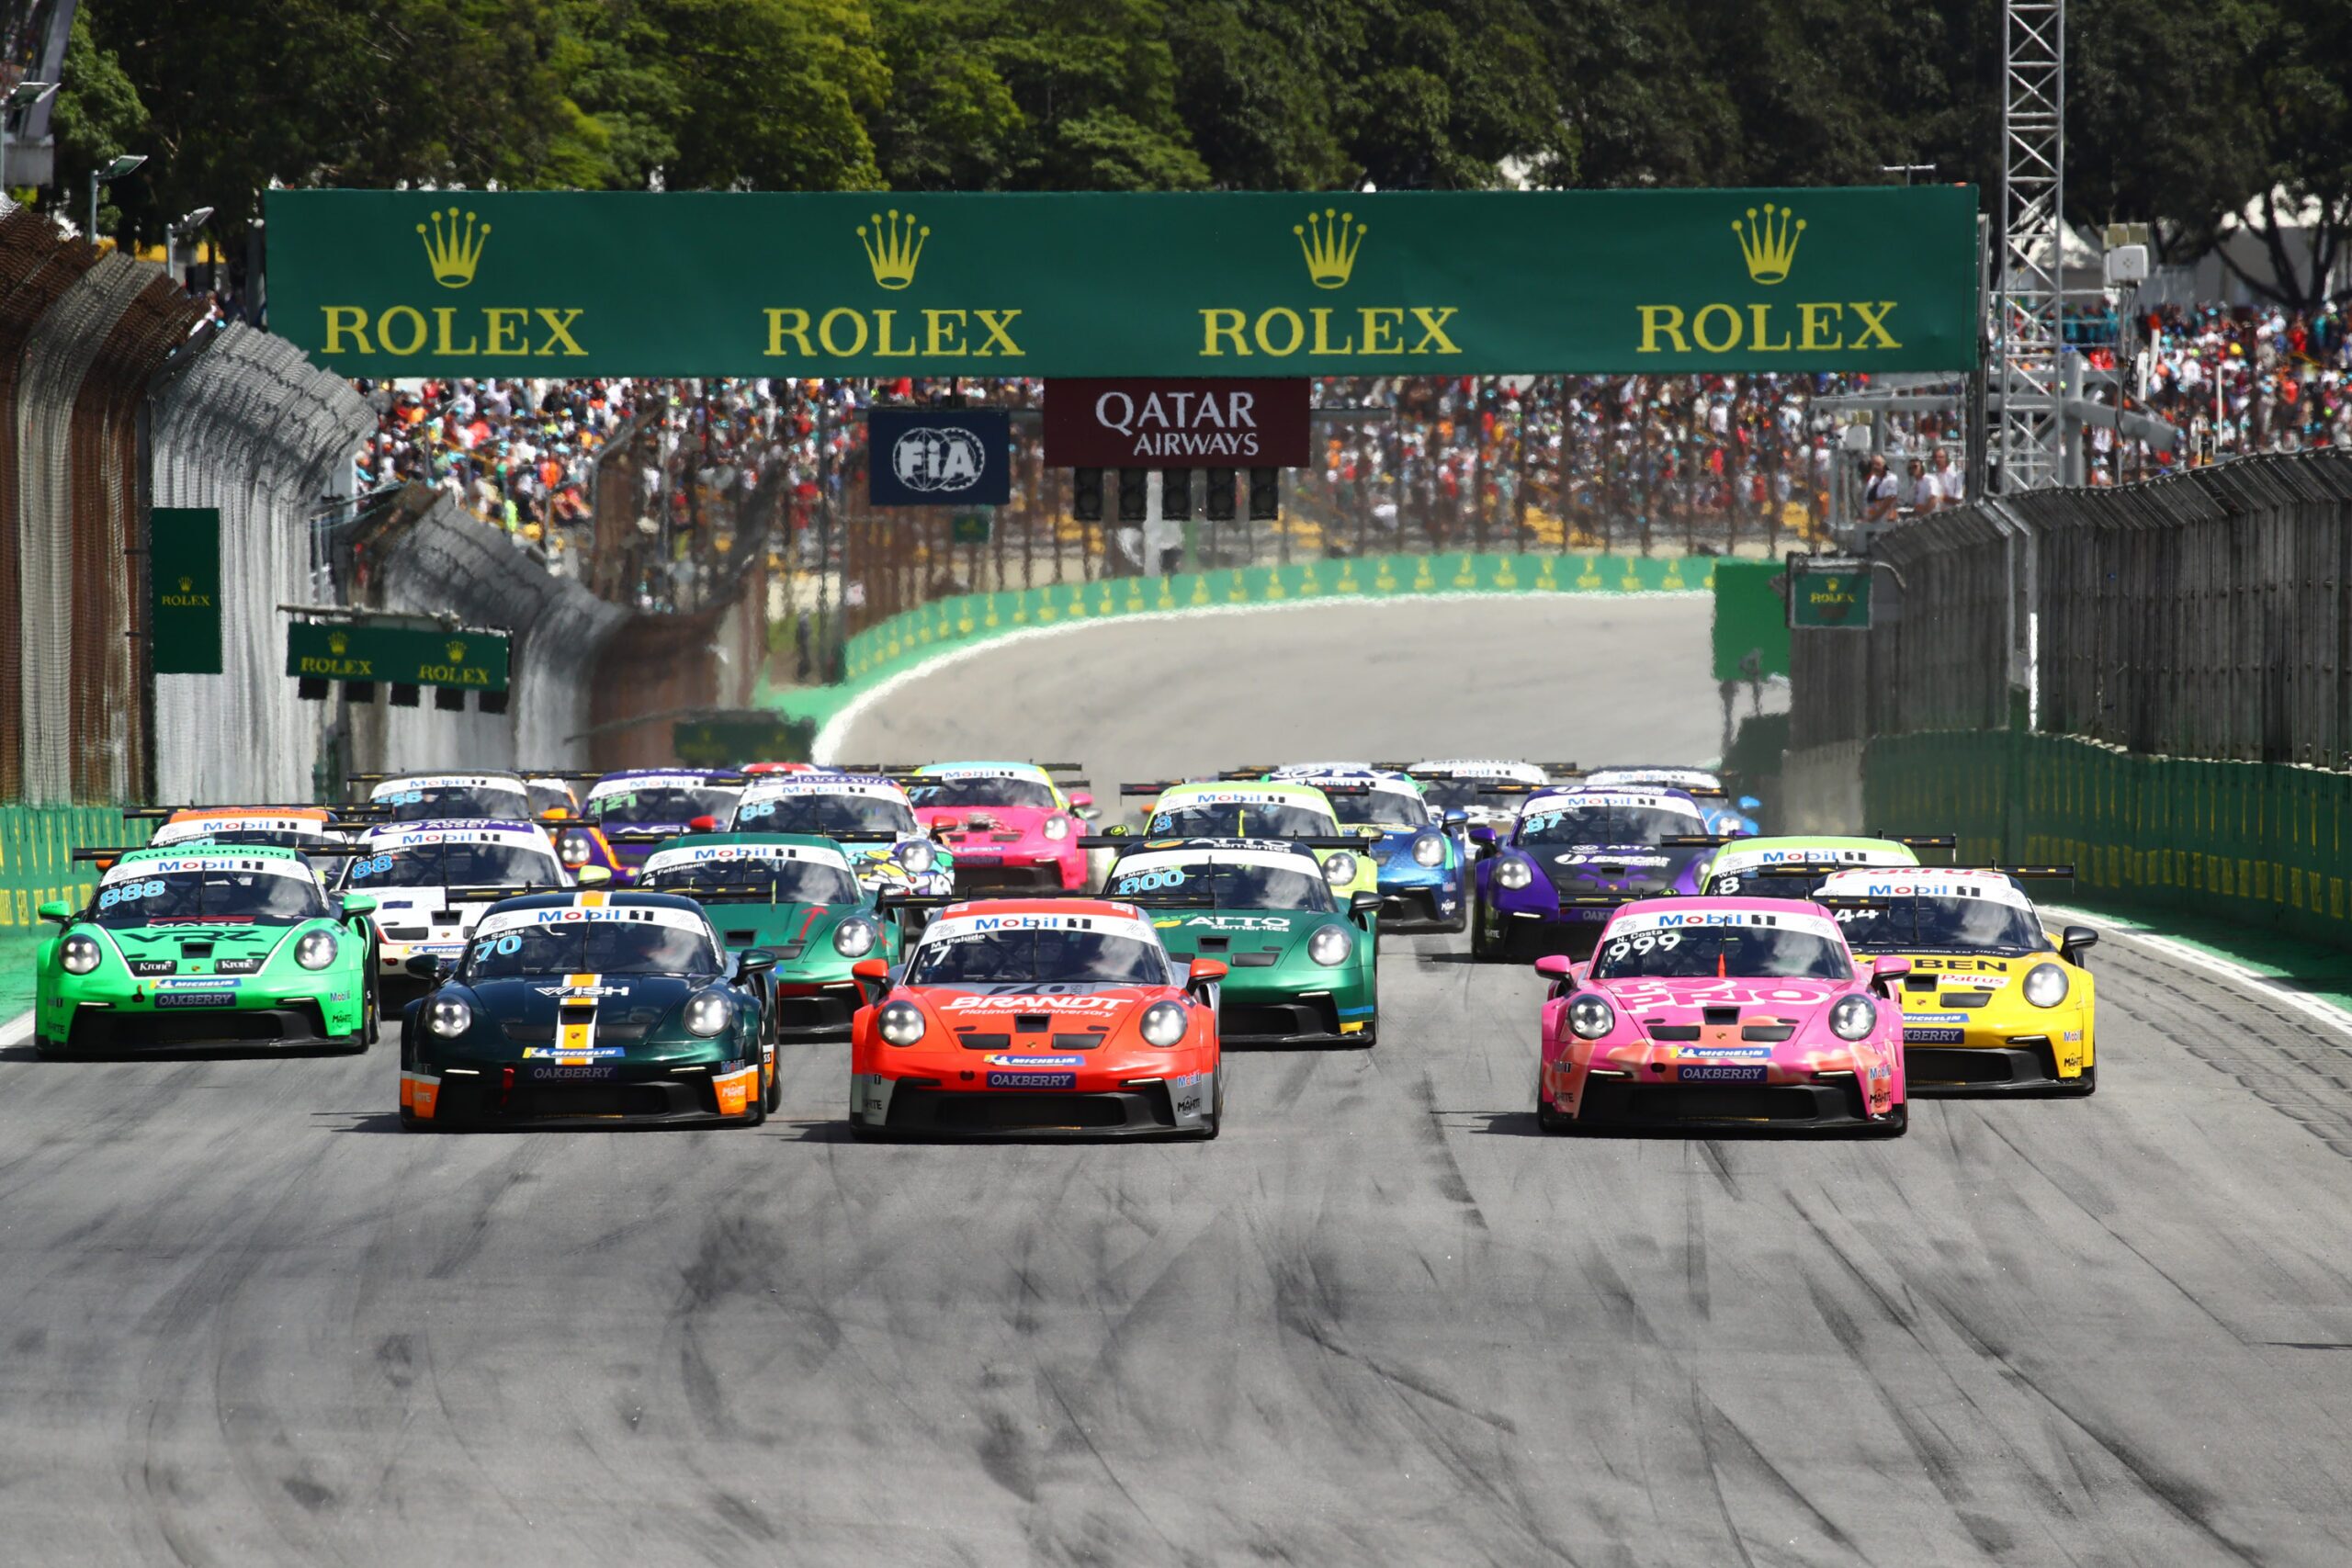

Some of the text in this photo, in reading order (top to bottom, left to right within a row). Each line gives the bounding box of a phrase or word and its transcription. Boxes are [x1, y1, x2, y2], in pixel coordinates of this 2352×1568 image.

[320, 305, 590, 357] ROLEX
[763, 307, 1026, 357] ROLEX
[1198, 306, 1463, 357] ROLEX
[1635, 301, 1904, 355] ROLEX
[1095, 391, 1258, 436] QATAR
[1133, 432, 1260, 457] AIRWAYS
[161, 594, 210, 607] ROLEX
[1809, 592, 1856, 604] ROLEX
[300, 656, 373, 676] ROLEX
[417, 664, 491, 686] ROLEX
[944, 770, 995, 780] Mobil
[1455, 768, 1490, 777] obil
[410, 779, 466, 788] Mobil
[629, 779, 687, 788] Mobil
[783, 785, 842, 794] Mobil
[588, 793, 638, 816] 121
[1196, 793, 1261, 804] Mobil
[1567, 796, 1631, 806] Mobil
[202, 821, 270, 832] Mobil
[1154, 815, 1172, 833] 3
[1525, 812, 1564, 833] 87
[401, 832, 473, 845] Mobil
[128, 846, 291, 863] AutoBanking
[695, 847, 768, 860] Mobil
[1212, 842, 1292, 853] sementes
[1762, 851, 1838, 863] Mobil
[157, 859, 234, 873] Mobil
[351, 854, 393, 880] 88
[657, 862, 707, 875] Feldmann
[119, 876, 146, 888] Pires
[1117, 869, 1185, 896] 800
[1719, 876, 1741, 896] 8
[97, 879, 166, 911] 888
[1868, 884, 1948, 897] Mobil
[537, 908, 621, 923] Mobil
[1185, 917, 1292, 928] ATTO
[1657, 913, 1743, 927] Mobil
[974, 917, 1058, 931] Mobil
[1209, 924, 1290, 932] sementes
[490, 928, 526, 941] Salles
[931, 932, 987, 950] M. Paludo
[1616, 928, 1664, 943] N. Costa
[474, 935, 523, 964] 70
[1608, 932, 1682, 963] 999
[930, 945, 952, 967] 7
[1914, 958, 2008, 973] BEN
[175, 979, 235, 987] MICHELIN
[1940, 973, 2005, 986] Patrus
[158, 993, 233, 1007] OAKBERRY
[940, 996, 1135, 1011] BRANDT
[958, 1006, 1026, 1017] Platinum
[1903, 1031, 1960, 1043] KBERRY
[550, 1048, 616, 1057] MICHELIN
[1698, 1048, 1764, 1057] MICHELIN
[1011, 1057, 1077, 1066] MICHELIN
[533, 1066, 614, 1080] OAKBERRY
[1682, 1067, 1763, 1081] OAKBERRY
[990, 1074, 1072, 1088] OAKBERRY
